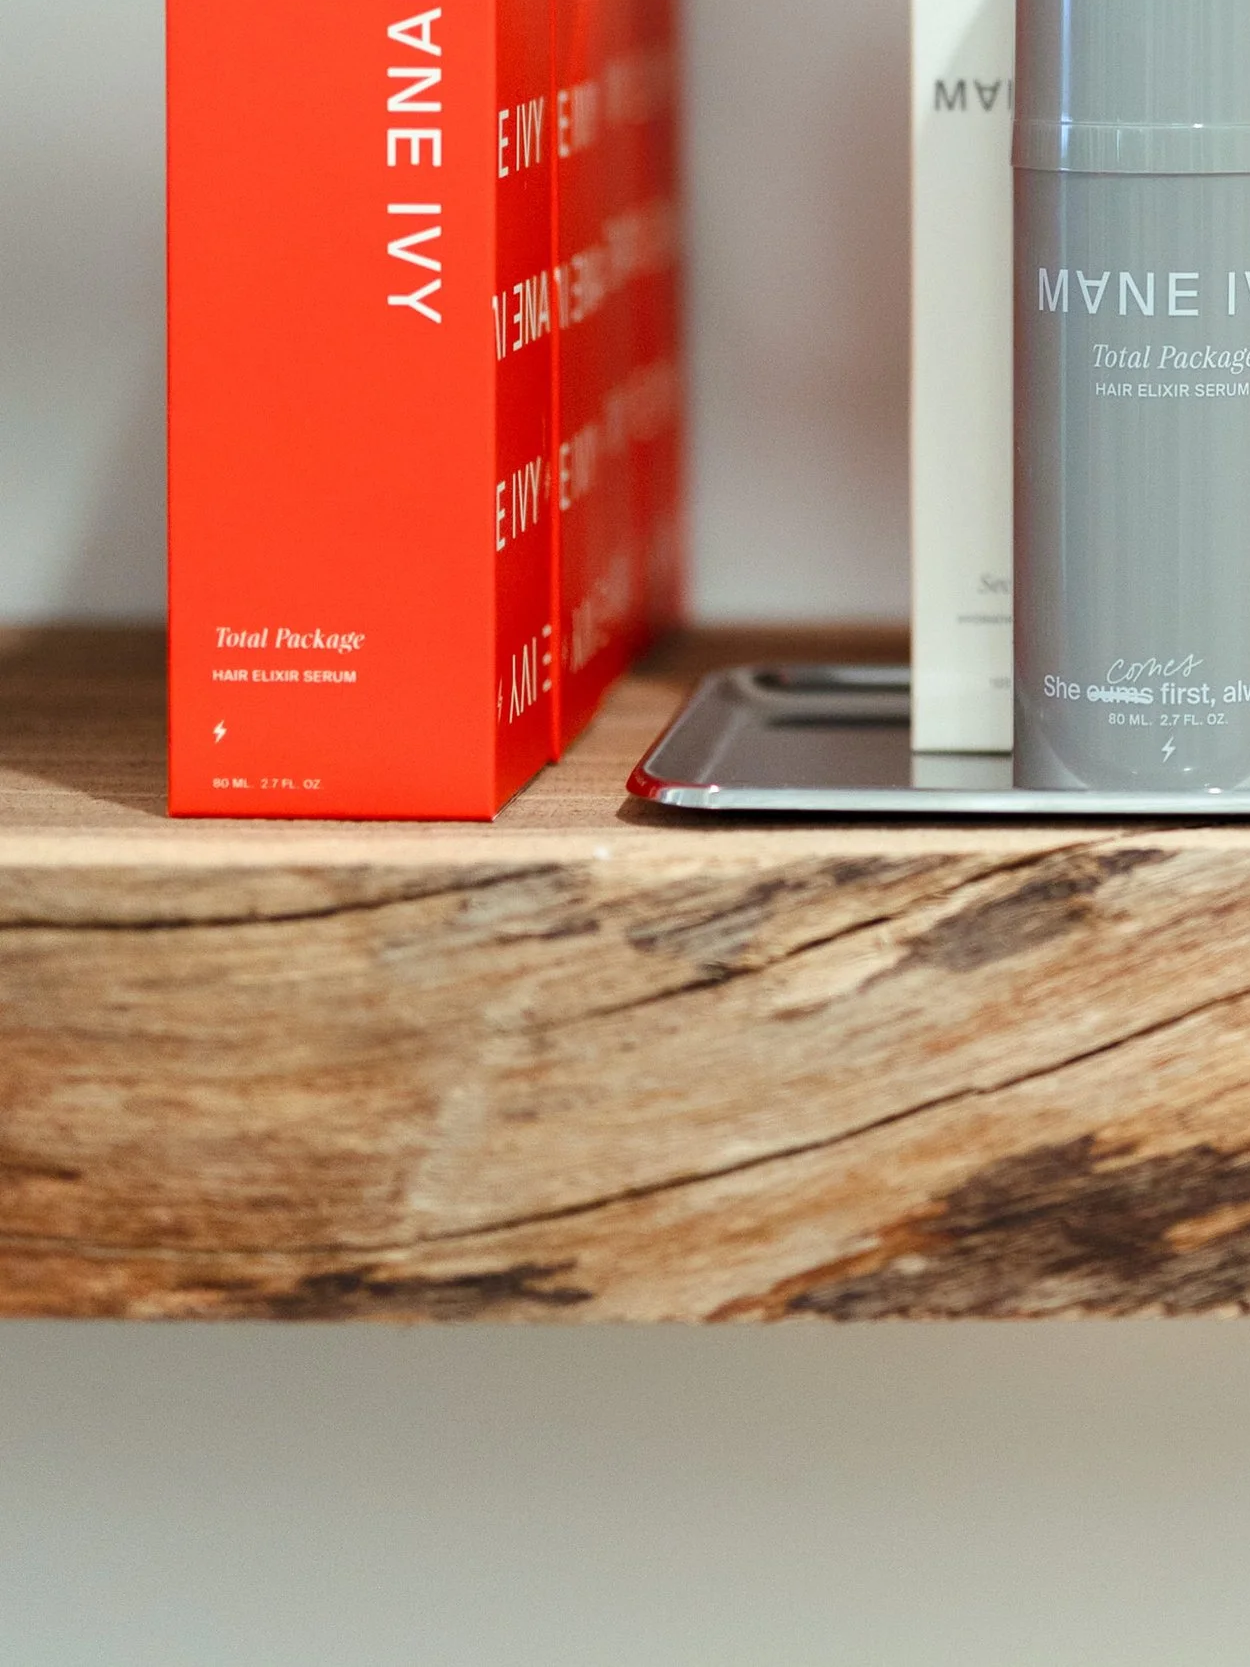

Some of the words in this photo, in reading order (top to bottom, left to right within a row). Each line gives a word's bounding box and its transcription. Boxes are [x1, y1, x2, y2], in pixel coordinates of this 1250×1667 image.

[387, 203, 442, 324] IVY
[1092, 343, 1151, 369] Total
[1095, 383, 1133, 396] HAIR
[1137, 384, 1190, 398] ELIXIR
[1194, 383, 1250, 398] SERUM
[215, 626, 269, 649] Total
[275, 627, 366, 655] Package
[212, 669, 249, 682] HAIR
[252, 669, 299, 683] ELIXIR
[303, 670, 357, 683] SERUM
[1043, 675, 1081, 700] She
[1160, 684, 1217, 707] first,
[1108, 713, 1126, 725] 80
[1129, 714, 1152, 726] ML.
[1160, 714, 1179, 726] 2.7
[1184, 714, 1203, 726] FL.
[1207, 713, 1229, 725] OZ.
